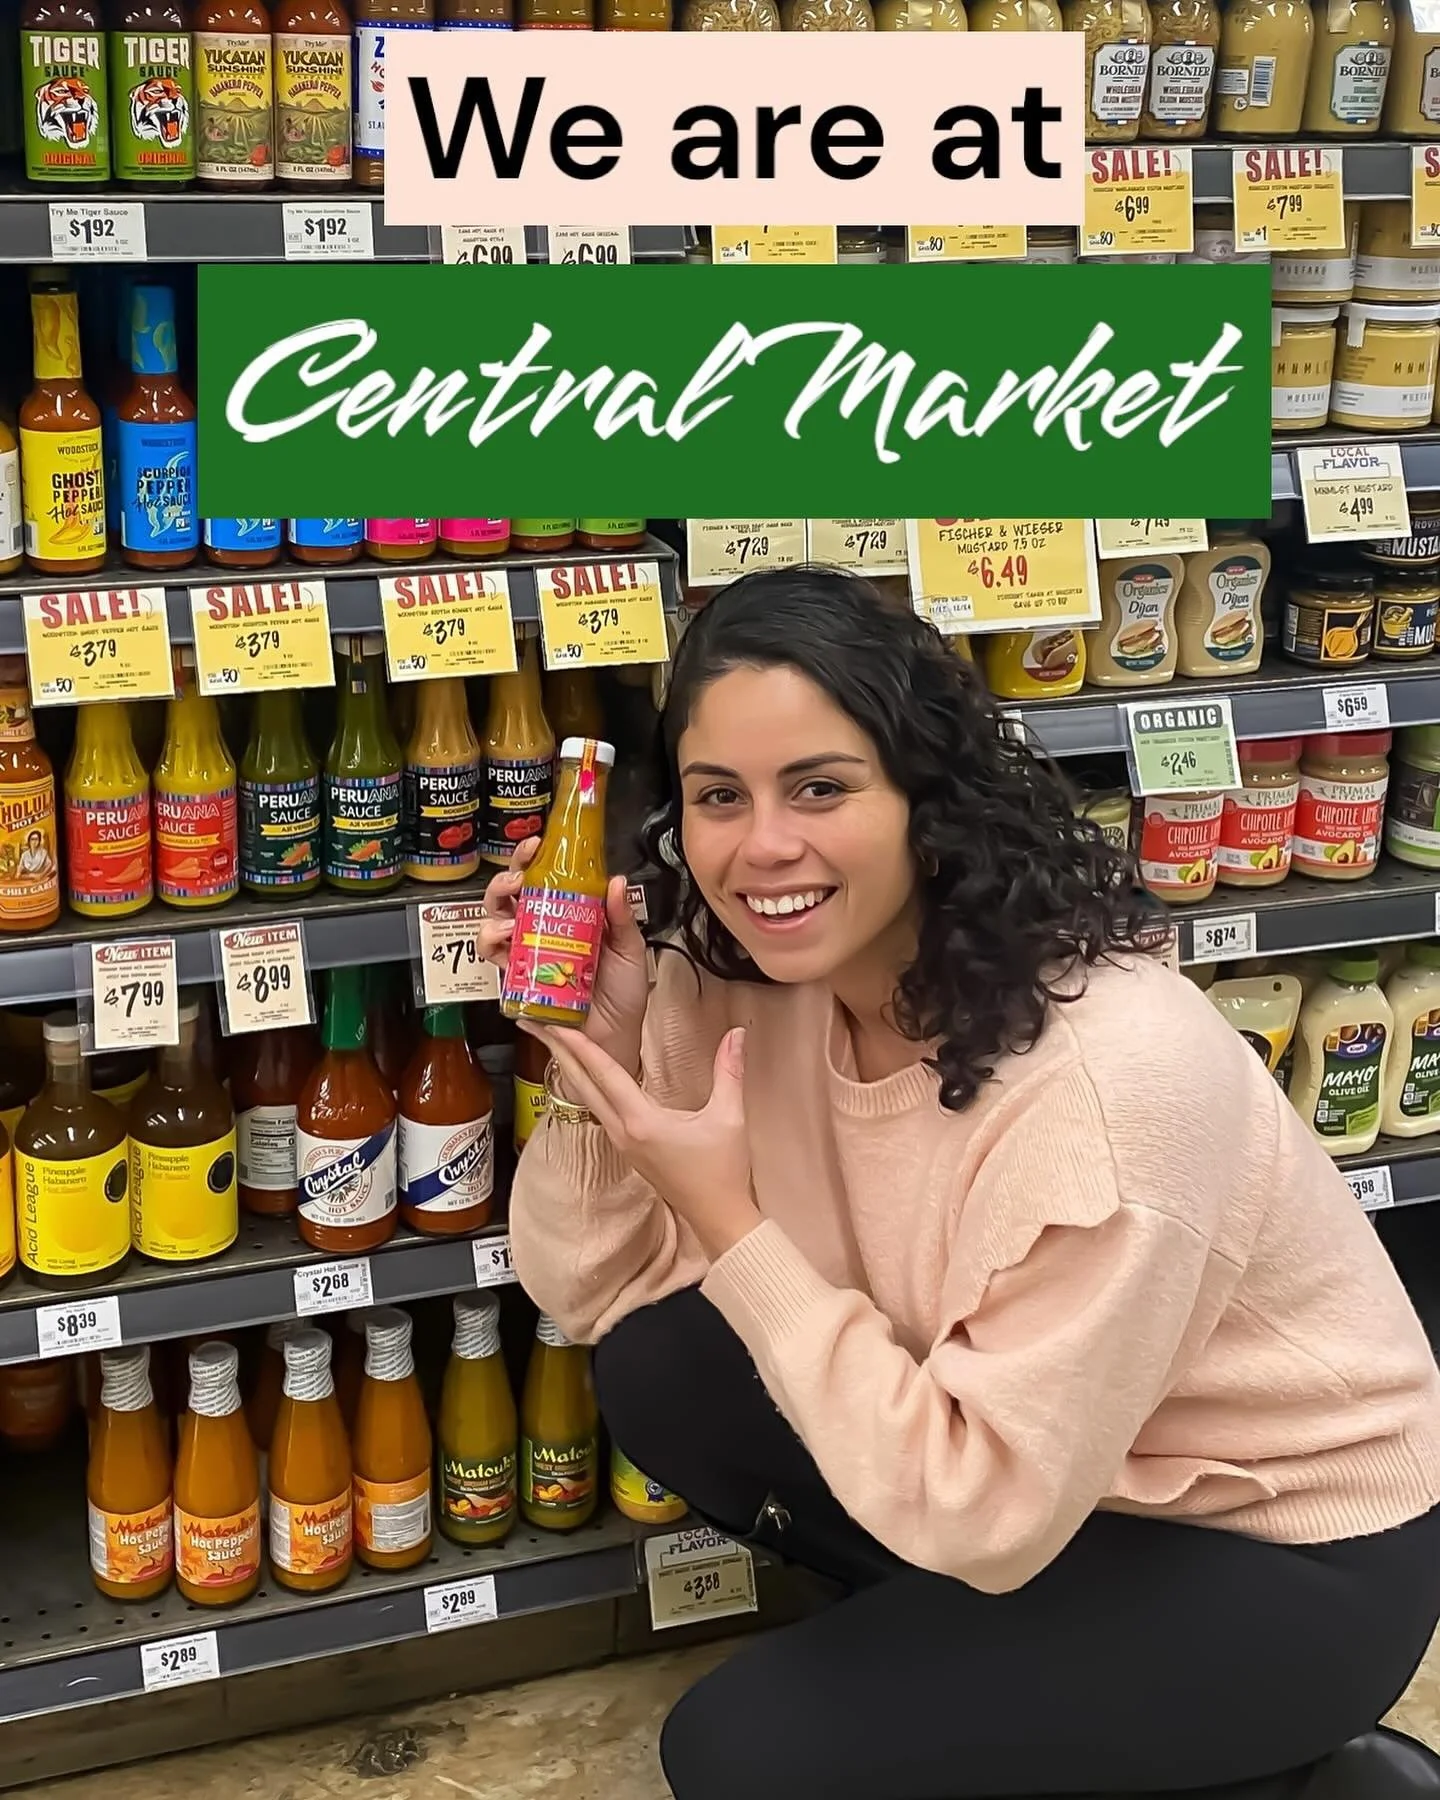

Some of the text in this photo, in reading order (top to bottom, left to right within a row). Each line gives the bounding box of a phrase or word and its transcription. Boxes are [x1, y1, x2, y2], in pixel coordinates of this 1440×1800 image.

[29, 36, 100, 70] TIGER
[124, 36, 190, 70] TIGER
[204, 49, 266, 65] YUCATAN
[283, 50, 344, 65] YUCATAN
[44, 65, 86, 77] SAUCE
[139, 65, 179, 77] SAUCE
[207, 64, 267, 73] SUNSHINE
[285, 65, 344, 74] SUNSHINE
[1100, 65, 1146, 76] BORNIE
[1157, 66, 1210, 76] BORNIER
[1340, 66, 1387, 77] BORNIE
[1091, 149, 1172, 184] SALE!
[1245, 149, 1322, 182] SALE!
[51, 208, 128, 217] Try Me Tiger Sauce
[69, 218, 115, 244] $192
[304, 217, 347, 243] $192
[58, 444, 99, 455] WOODSTOCK
[1330, 447, 1370, 458] LOCAL
[1322, 457, 1380, 469] FLAVOR
[52, 470, 101, 489] GHOST
[47, 505, 78, 524] Hot
[1339, 497, 1374, 522] $499
[939, 521, 1064, 541] FISCHER & WIESER
[958, 537, 1046, 554] MUSTARD 7.5 OZ
[1392, 536, 1440, 557] MUSTA
[968, 554, 1028, 588] $6.49
[395, 572, 485, 609] SALE!
[550, 563, 638, 599] SALE!
[1123, 582, 1168, 599] Organics
[1216, 574, 1257, 591] Organics
[40, 590, 140, 629] SALE!
[206, 581, 302, 621] SALE!
[1128, 601, 1159, 619] Dijon
[1222, 592, 1249, 610] Dijon
[578, 608, 619, 634] $379
[423, 618, 465, 645] $379
[70, 639, 116, 667] $379
[235, 630, 280, 658] $379
[1337, 697, 1368, 717] $659
[1140, 708, 1217, 730] ORGANIC
[1161, 751, 1196, 776] $246
[331, 785, 399, 804] PERUANA
[430, 790, 469, 805] SAUCE
[497, 785, 537, 797] SAUCE
[1332, 785, 1375, 795] PRIMAL
[157, 802, 220, 820] ERUANA
[270, 807, 311, 824] SAUCE
[340, 805, 381, 818] SAUCE
[1315, 804, 1359, 826] CHIPOTLE
[11, 819, 33, 830] HOT
[159, 818, 196, 834] SAUCE
[1241, 812, 1281, 831] CHIPOTLE
[98, 823, 141, 841] SAUCE
[1168, 822, 1208, 845] CHIPOTLE
[1241, 836, 1283, 845] AVOCADO
[1315, 830, 1360, 839] AVOCADO
[1168, 849, 1210, 858] AVOCADO
[430, 906, 461, 921] New
[525, 899, 597, 926] PERUANA
[531, 919, 575, 937] SAUCE
[1206, 926, 1236, 948] $874
[233, 929, 297, 949] New ITEM
[104, 945, 171, 963] New ITEM
[236, 964, 290, 1003] $899
[104, 980, 164, 1017] $799
[1323, 1065, 1378, 1088] MAYO
[1329, 1087, 1356, 1096] OLIVE
[148, 1152, 189, 1163] Pineapple
[148, 1162, 190, 1172] Habanero
[43, 1166, 87, 1177] Pineapple
[43, 1176, 87, 1185] Habanero
[304, 1152, 365, 1197] Crystal
[350, 1183, 370, 1208] SAUCE
[1347, 1180, 1374, 1200] 398
[25, 1162, 39, 1265] Acid League
[297, 1268, 322, 1278] Crystal
[312, 1273, 349, 1297] $268
[57, 1311, 96, 1337] $839
[120, 1533, 143, 1545] Hot
[190, 1527, 254, 1549] Hot Pepper
[304, 1524, 327, 1536] Hot
[442, 1590, 476, 1613] $289
[161, 1646, 197, 1671] $289
